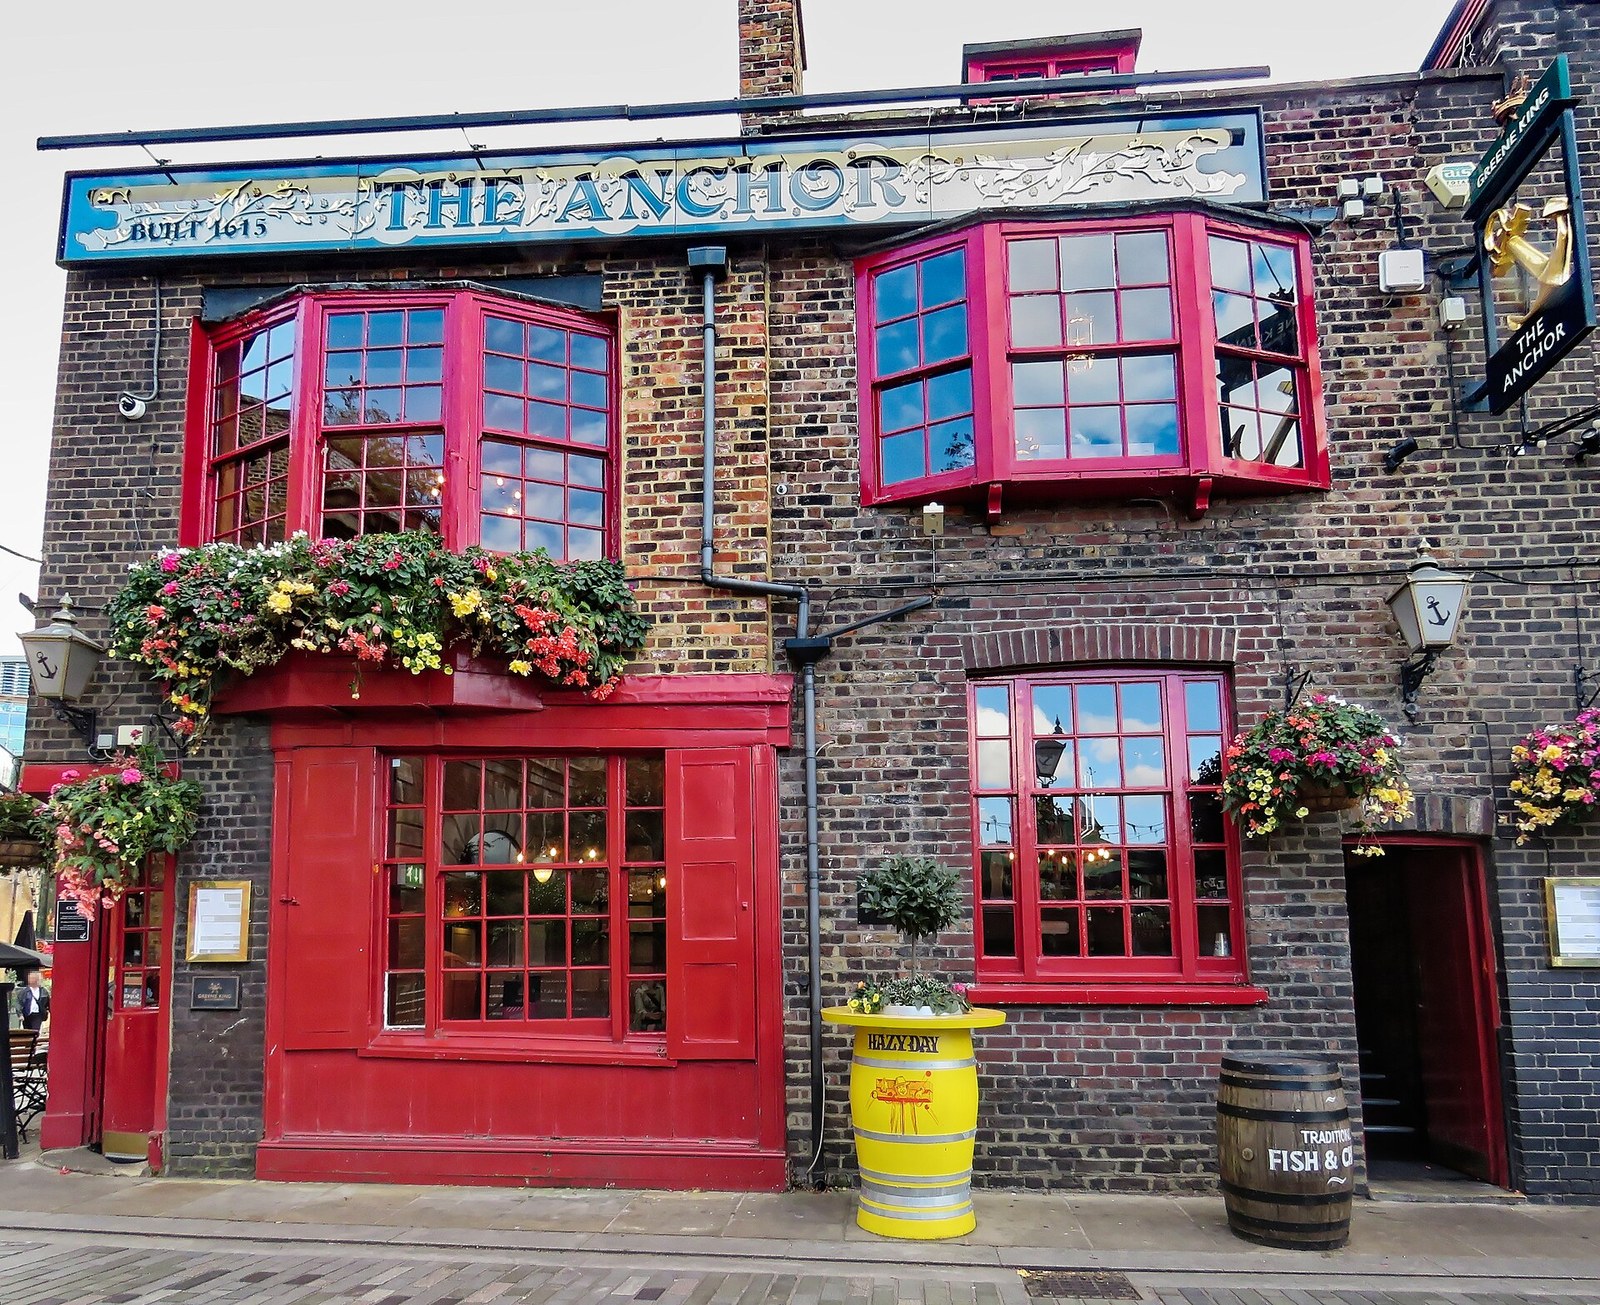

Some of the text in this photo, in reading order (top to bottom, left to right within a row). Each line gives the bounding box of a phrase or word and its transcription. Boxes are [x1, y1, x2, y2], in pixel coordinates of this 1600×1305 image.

[1477, 87, 1549, 188] GREENE KING
[373, 153, 906, 231] THE ANCHOR
[130, 218, 268, 241] BUILT 1615
[1516, 317, 1545, 354] THE
[1503, 322, 1566, 393] ANCHOR
[868, 1033, 939, 1054] HAZY DAY
[1268, 1149, 1319, 1172] FISH
[1324, 1150, 1338, 1171] &
